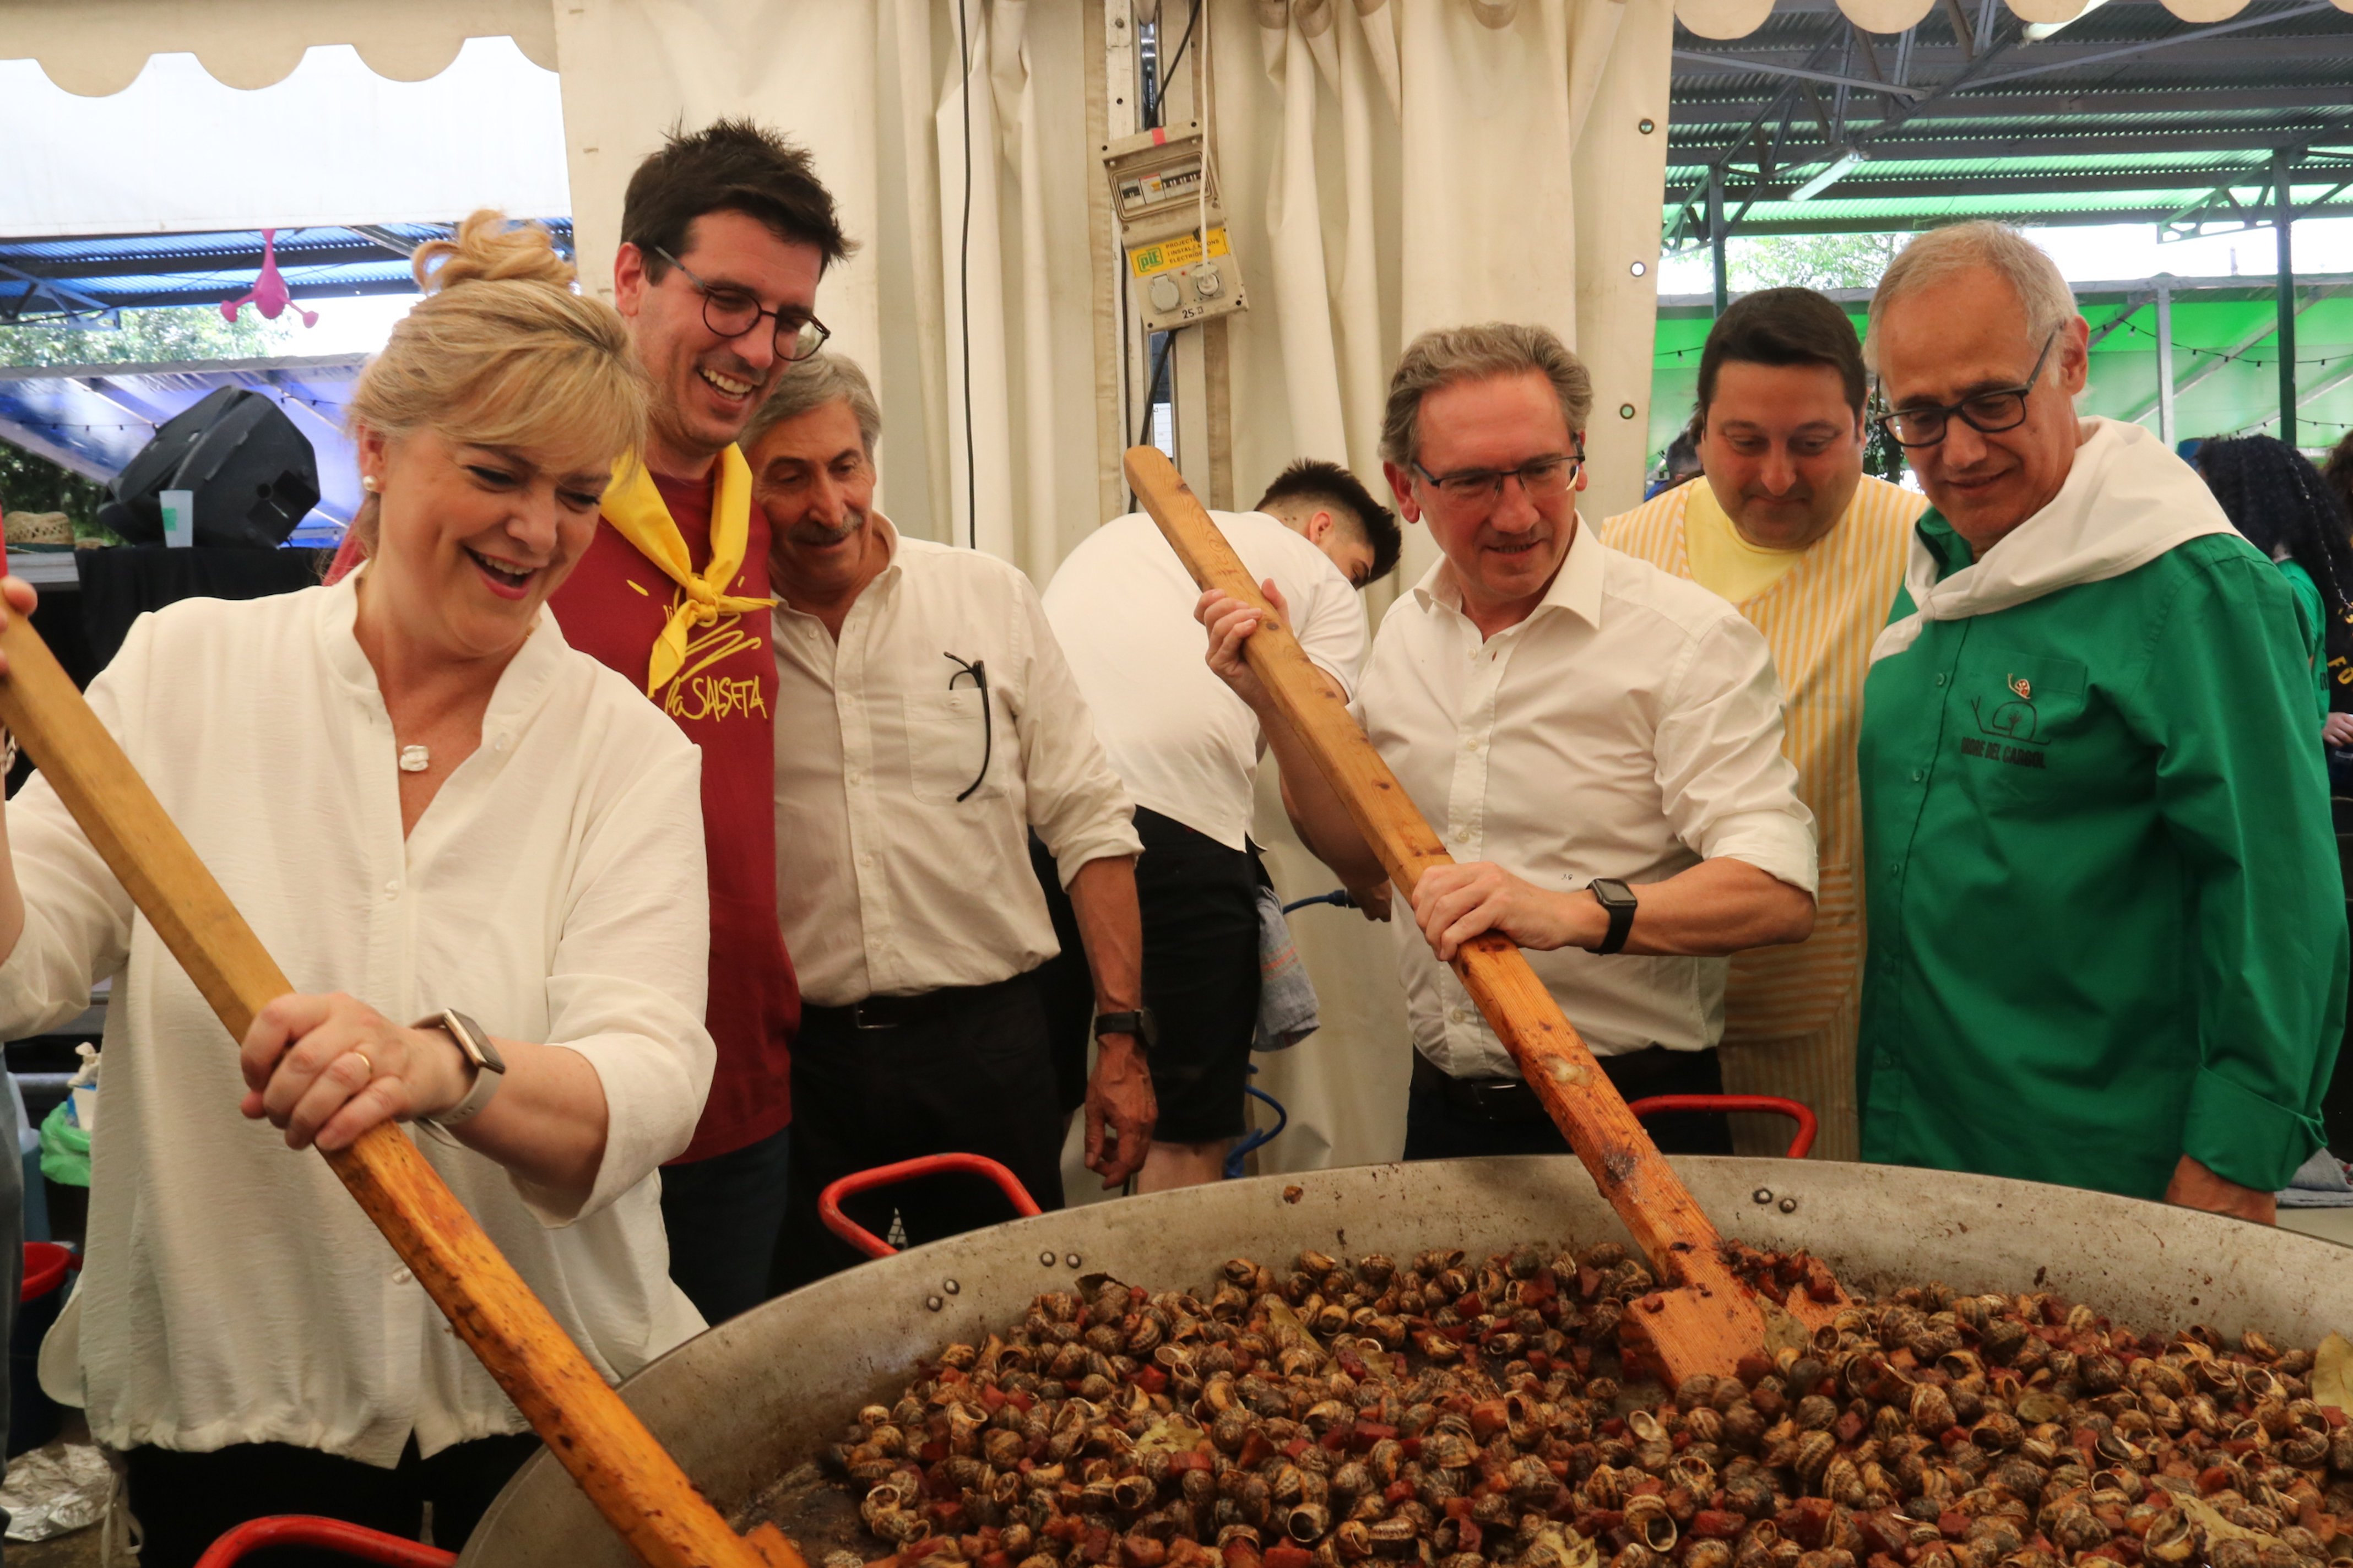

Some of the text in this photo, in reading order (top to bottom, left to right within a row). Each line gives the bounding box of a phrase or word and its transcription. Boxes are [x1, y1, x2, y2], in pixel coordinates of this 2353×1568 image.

[1169, 249, 1211, 264] ELECTRIQUS
[1182, 308, 1194, 319] 25
[691, 675, 768, 722] SALSETA
